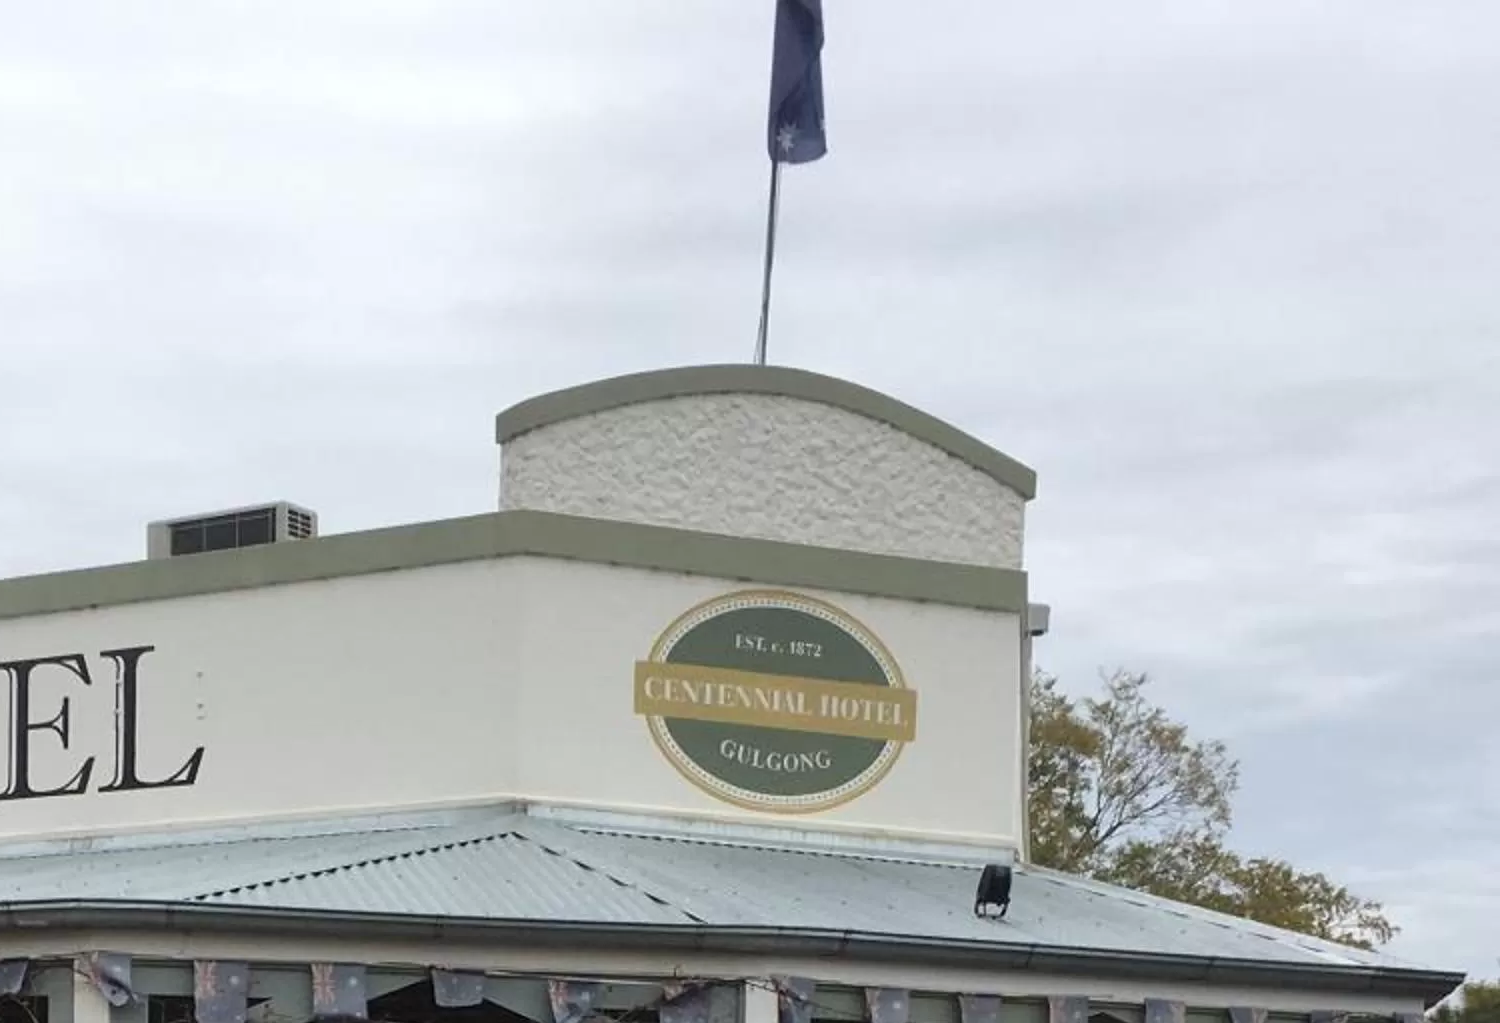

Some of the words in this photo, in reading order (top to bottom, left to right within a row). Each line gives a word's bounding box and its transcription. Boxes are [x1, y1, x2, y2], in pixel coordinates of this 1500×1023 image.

[789, 640, 824, 658] 1872
[643, 676, 812, 716] CENTENNIAL
[820, 692, 908, 727] HOTEL
[719, 739, 832, 773] GULGONG
